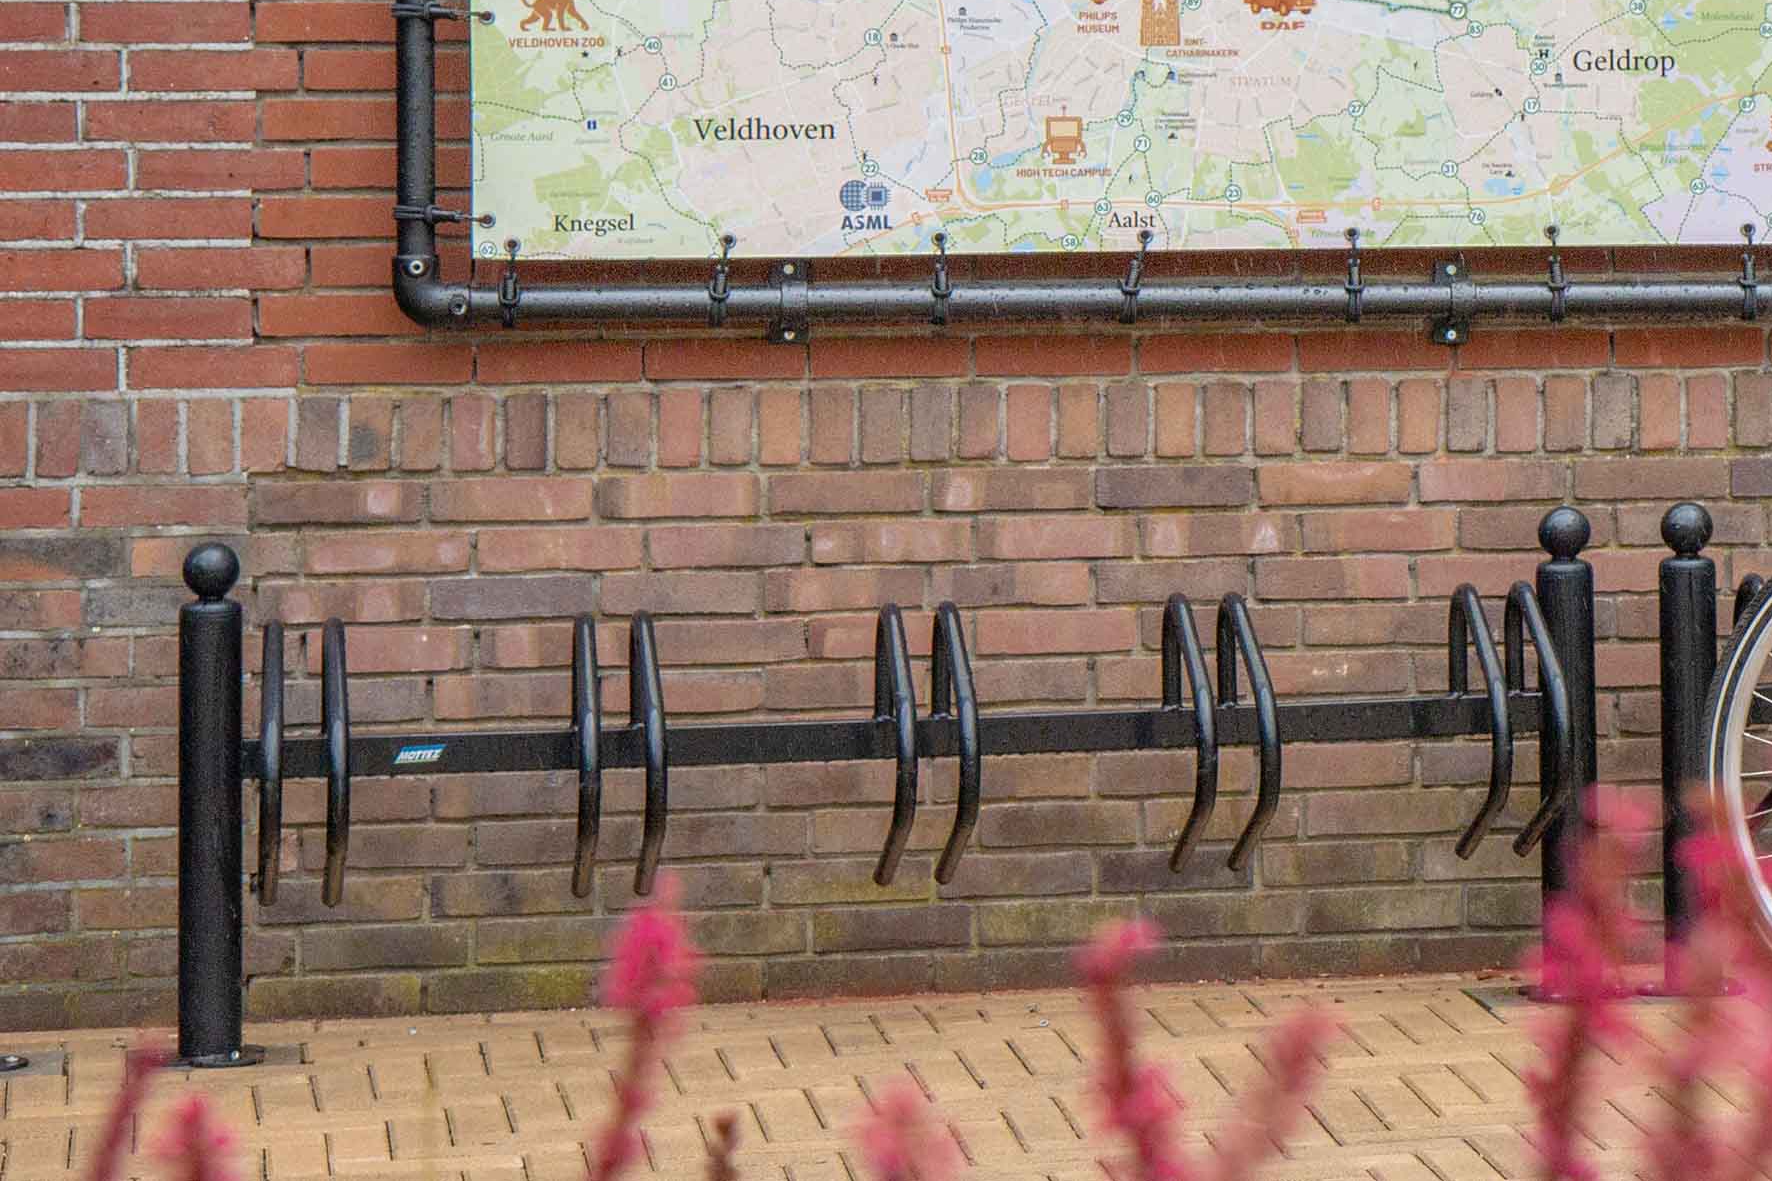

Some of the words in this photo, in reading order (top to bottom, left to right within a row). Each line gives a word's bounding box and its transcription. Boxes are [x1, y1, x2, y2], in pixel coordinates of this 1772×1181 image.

[1078, 12, 1118, 21] PHILIPS
[1077, 23, 1120, 34] MUSEUM
[1260, 21, 1306, 30] DAF
[509, 37, 578, 48] VELDHOVEN
[581, 37, 605, 48] ZOO
[1573, 49, 1675, 77] Geldrop
[693, 119, 836, 141] Veldhoven
[1016, 168, 1043, 178] HIGH
[1047, 168, 1068, 178] TECH
[1070, 168, 1112, 178] CAMPUS
[553, 214, 635, 235] Knegsel
[841, 216, 893, 230] ASML
[1108, 212, 1157, 228] Aalst
